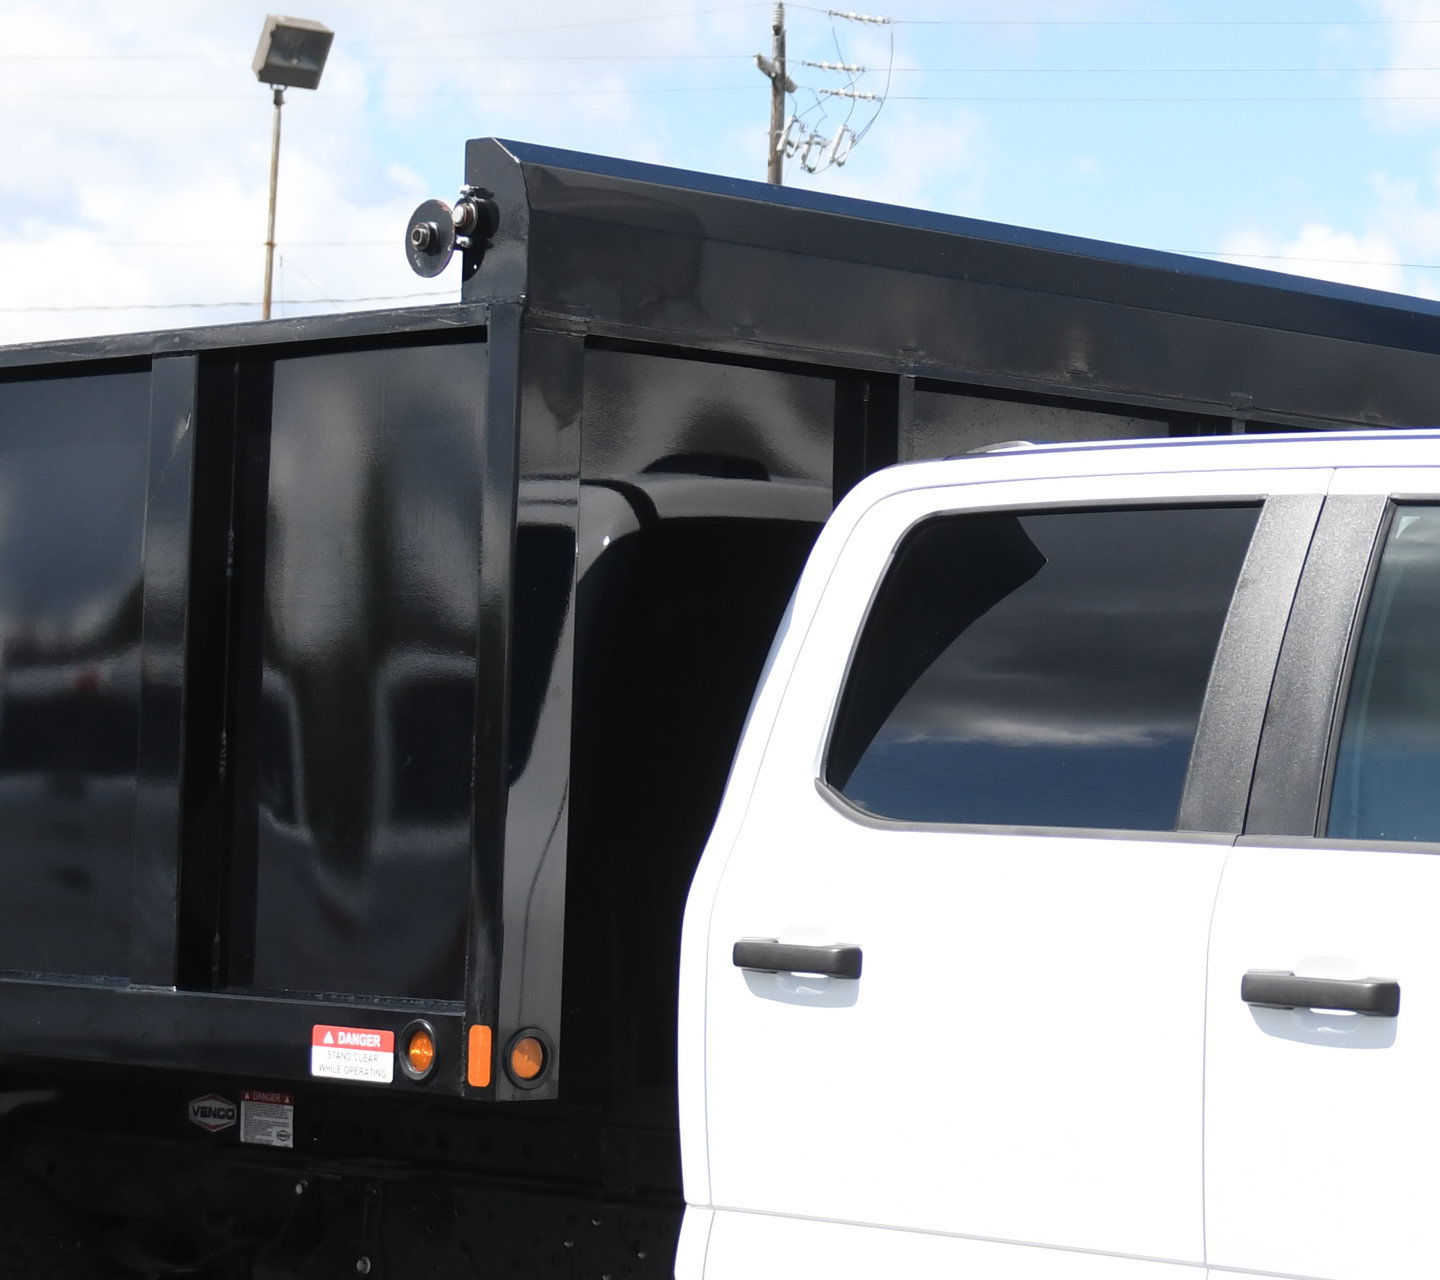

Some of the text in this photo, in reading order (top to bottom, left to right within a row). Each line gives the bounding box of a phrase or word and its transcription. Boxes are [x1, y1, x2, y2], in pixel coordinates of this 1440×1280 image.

[337, 1031, 381, 1047] DANGER
[327, 1050, 379, 1063] STAND CLEAR
[319, 1064, 387, 1078] WHILE OPERATING
[192, 1105, 236, 1120] VENCO
